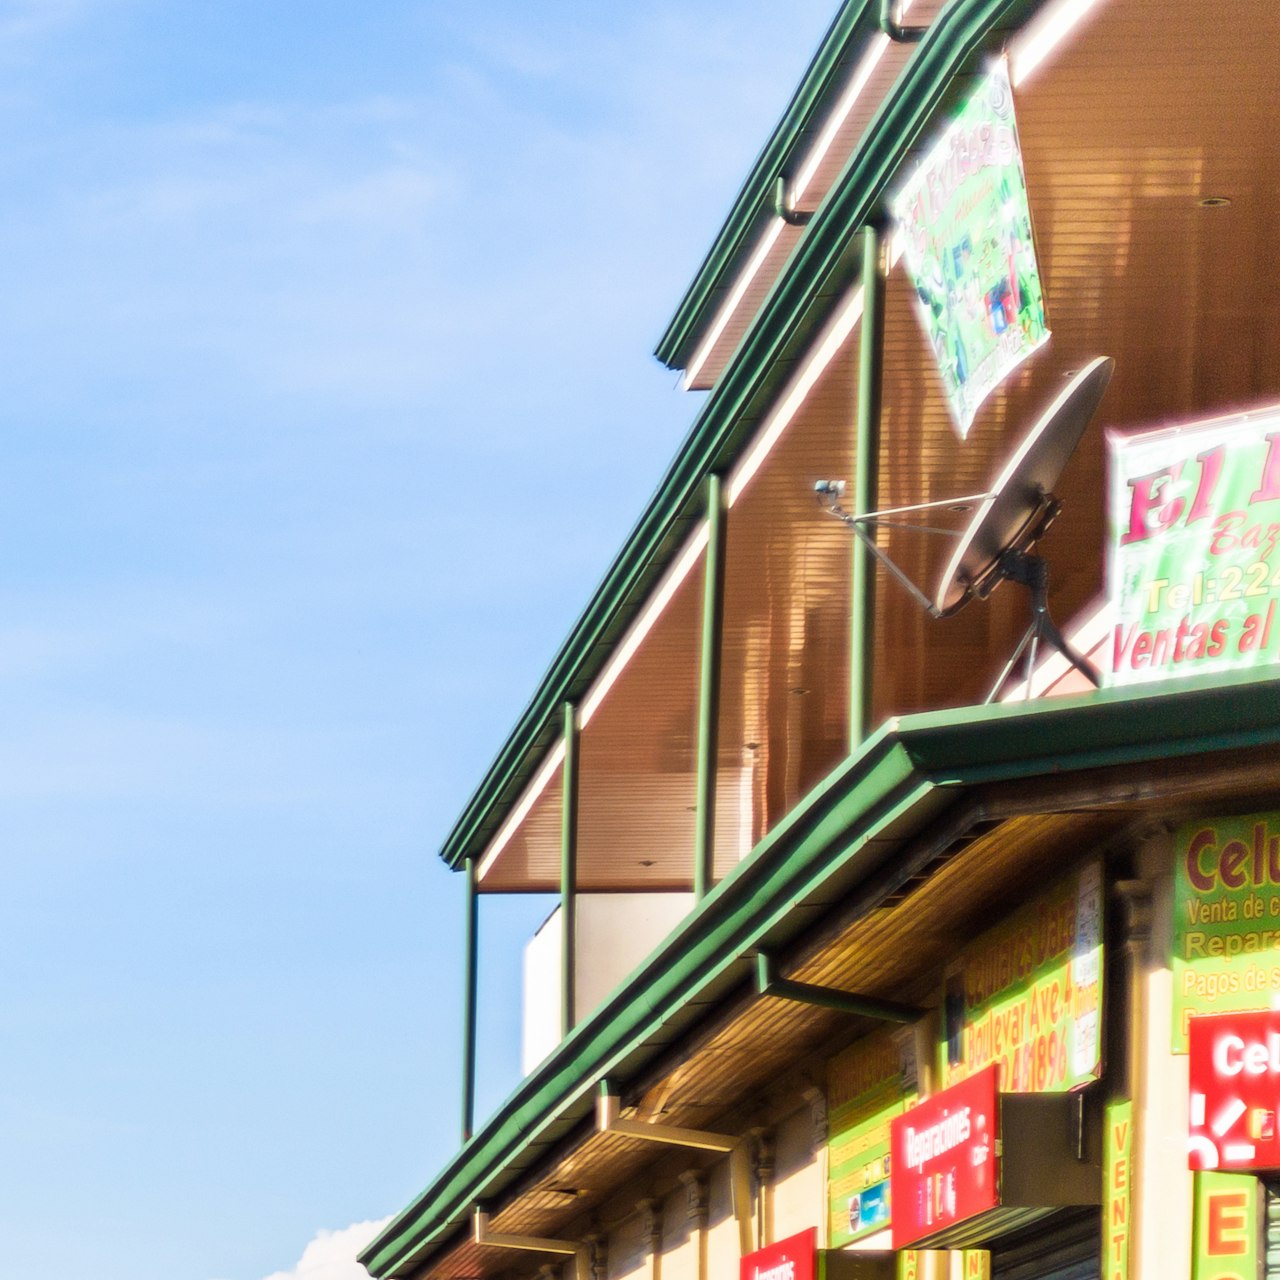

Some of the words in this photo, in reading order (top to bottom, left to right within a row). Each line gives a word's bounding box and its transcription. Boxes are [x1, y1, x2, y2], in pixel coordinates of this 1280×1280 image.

[1120, 443, 1226, 547] El
[1112, 613, 1230, 673] Ventas
[1237, 599, 1276, 654] al
[1188, 896, 1238, 926] Venta
[1243, 892, 1264, 920] de
[1184, 970, 1239, 1000] Pagos
[1245, 963, 1266, 992] de
[968, 1000, 1027, 1071] Boulevar
[907, 1107, 971, 1174] Reparaciones
